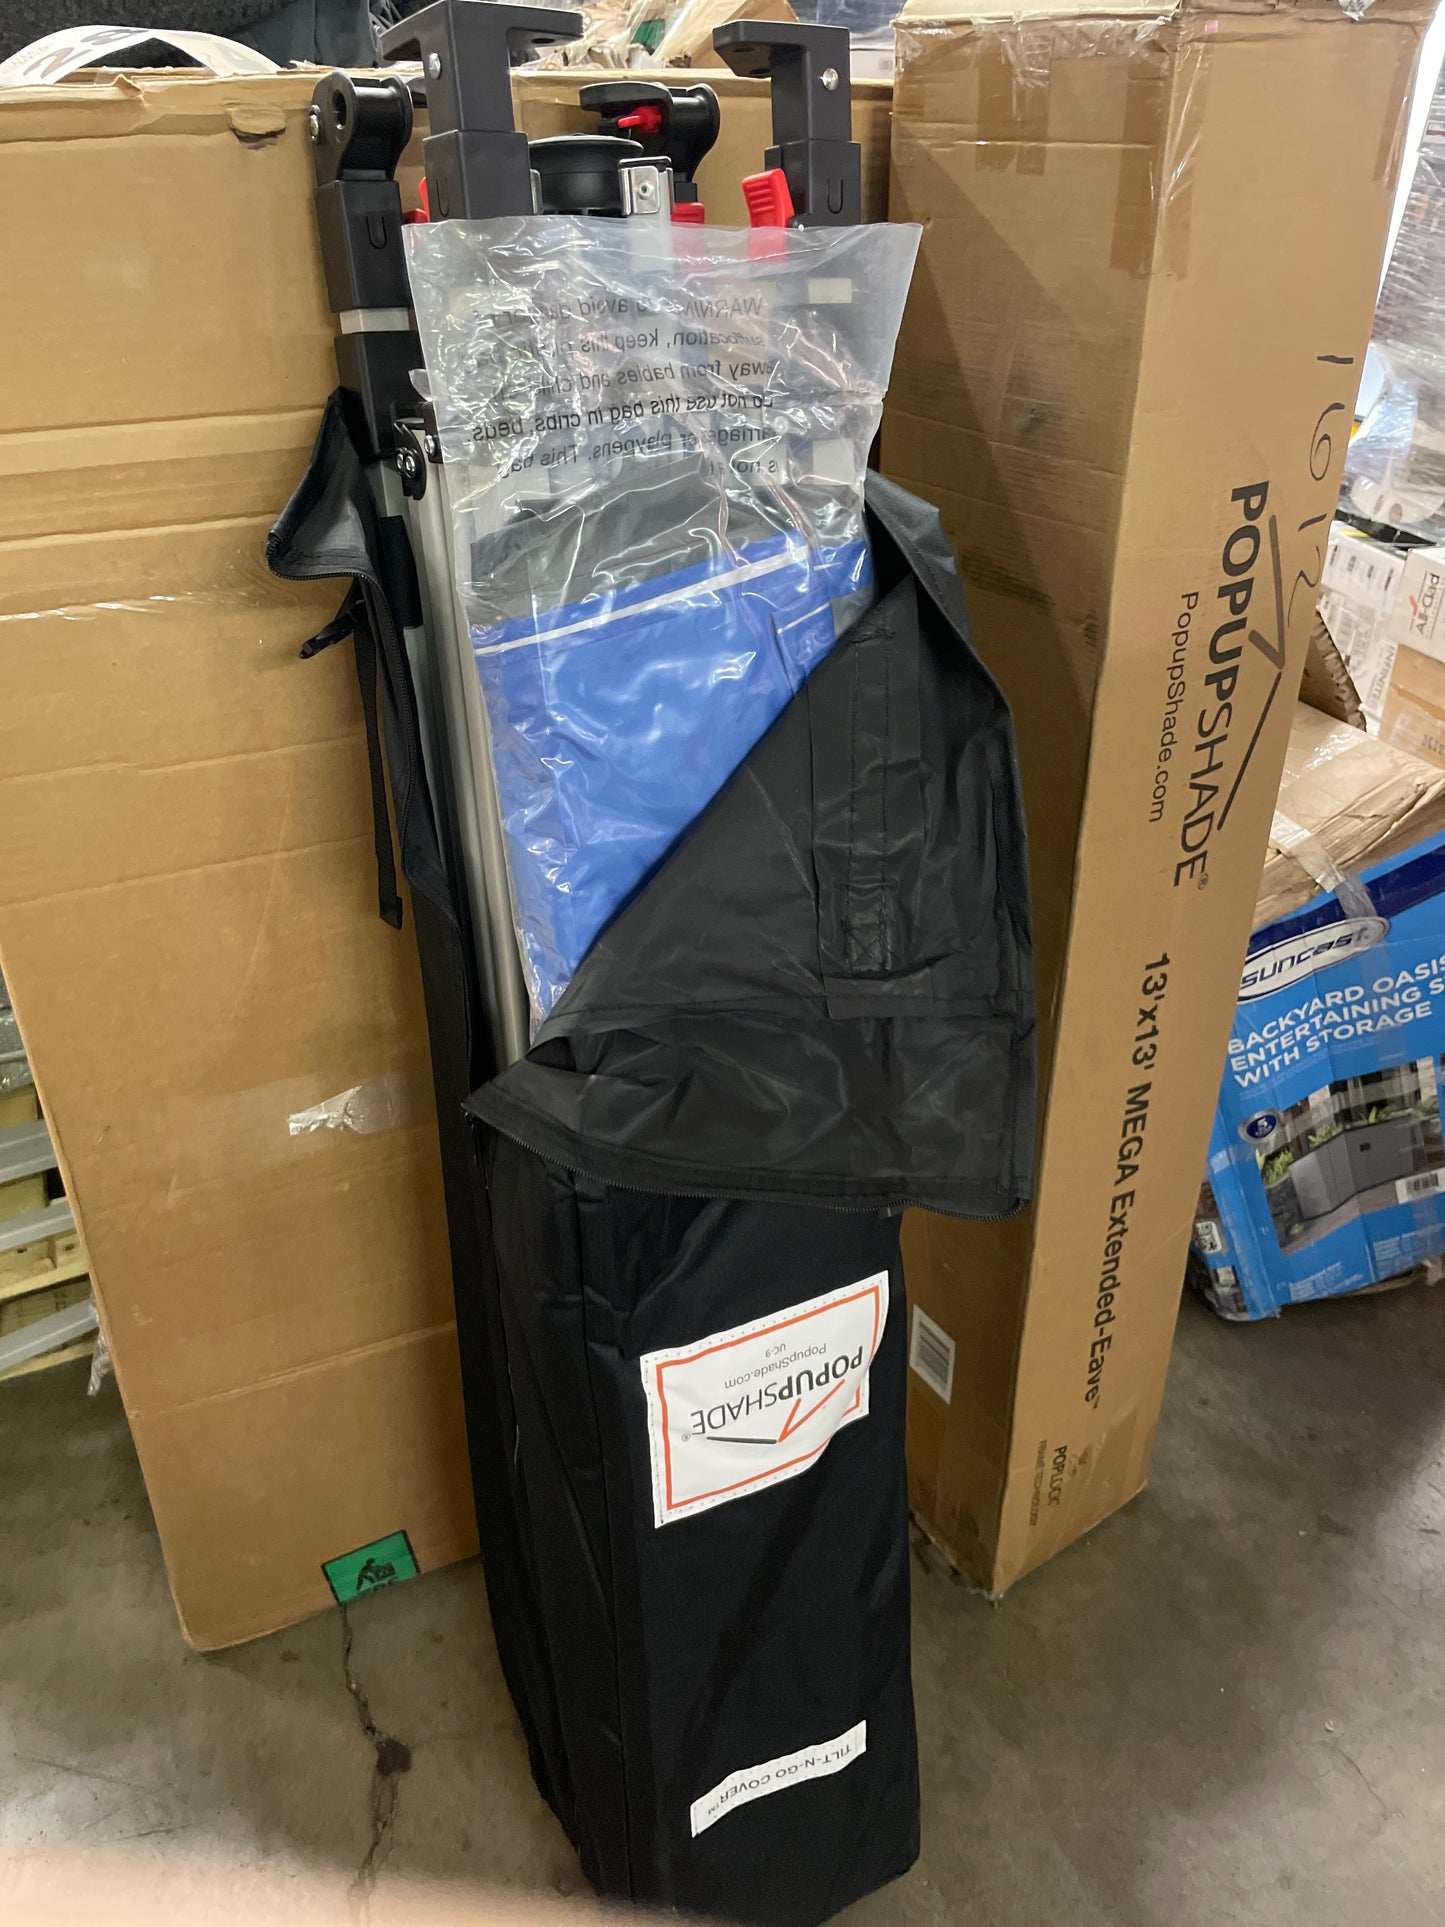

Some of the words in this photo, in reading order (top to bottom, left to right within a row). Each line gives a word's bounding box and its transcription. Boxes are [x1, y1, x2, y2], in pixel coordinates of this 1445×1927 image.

[1416, 573, 1440, 636] All-Clad
[1148, 590, 1200, 824] PopupShade.com
[1131, 952, 1170, 1071] 13'x13'
[1227, 984, 1365, 1056] BACKYARD
[1230, 985, 1422, 1073] ENTERTAINING
[1233, 1046, 1301, 1089] WITH
[1306, 1000, 1433, 1054] STORAGE
[1112, 1081, 1153, 1187] MEGA
[723, 1342, 828, 1391] PopupShade.com
[764, 1342, 787, 1360] UC-9
[775, 1743, 852, 1778] TILT-N-GO
